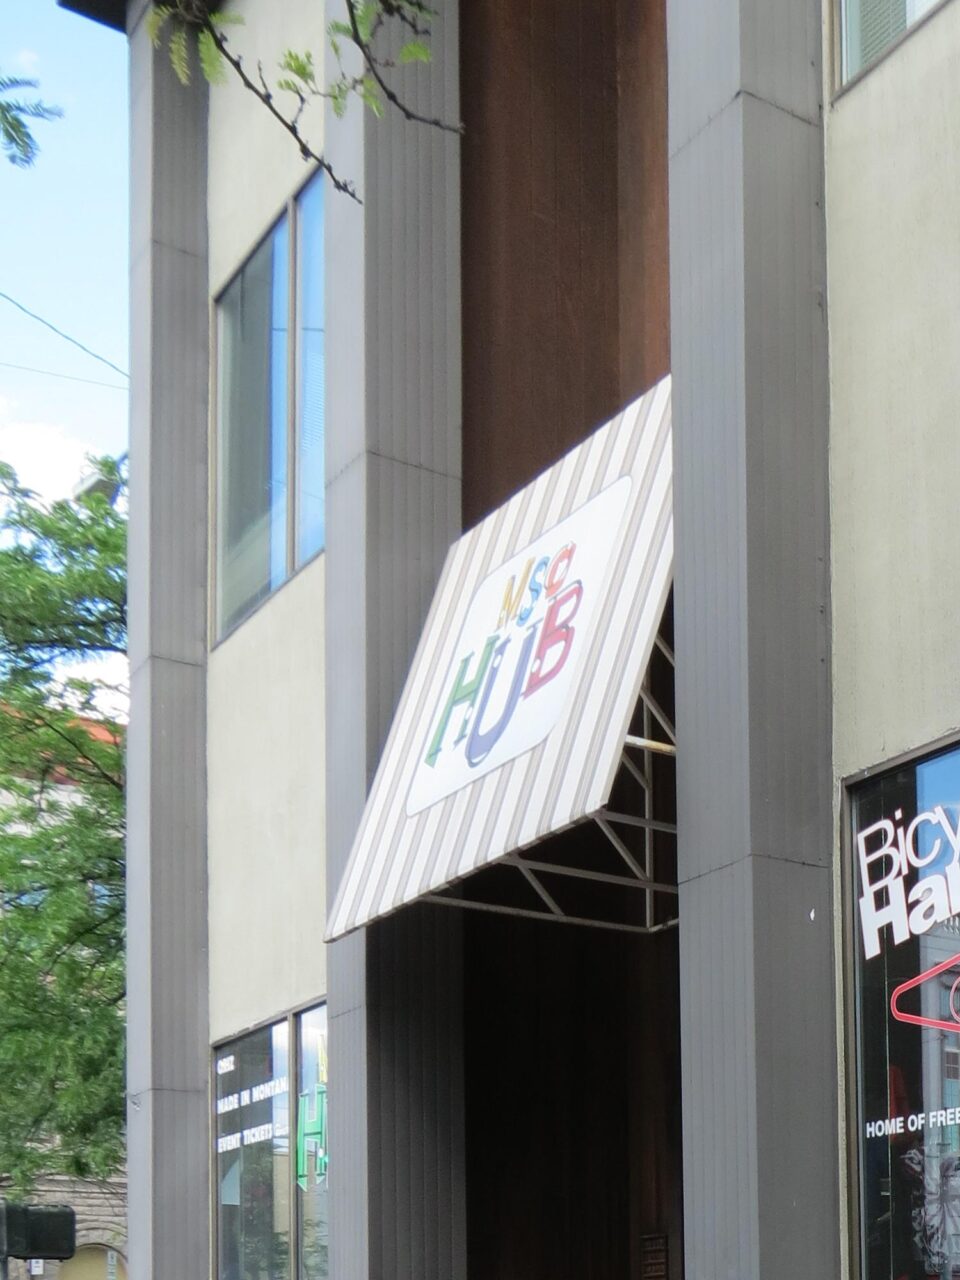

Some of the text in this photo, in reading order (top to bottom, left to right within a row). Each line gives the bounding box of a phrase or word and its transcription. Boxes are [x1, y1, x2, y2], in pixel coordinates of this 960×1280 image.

[424, 579, 583, 769] HUB
[217, 1093, 239, 1114] MADE
[240, 1089, 251, 1107] IN
[217, 1132, 241, 1153] EVENT
[243, 1123, 273, 1145] TICKETS
[866, 1117, 904, 1138] HOME
[907, 1113, 926, 1132] OF
